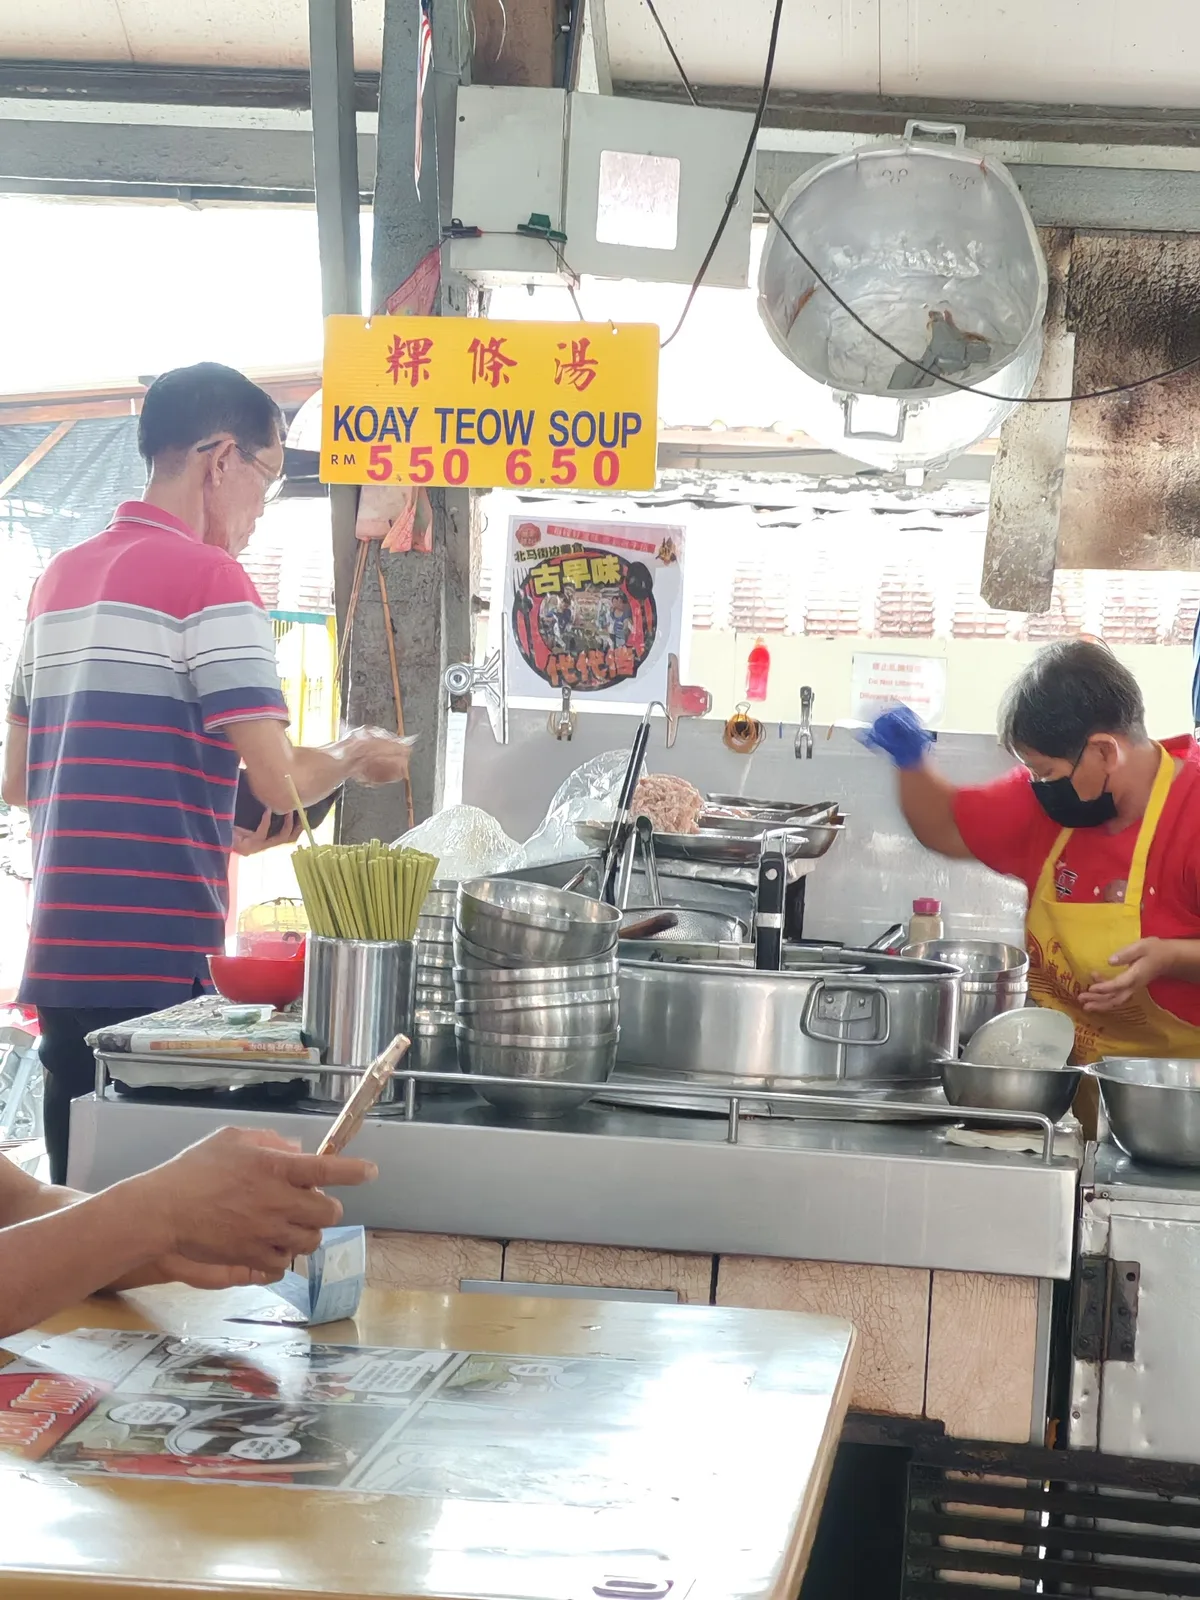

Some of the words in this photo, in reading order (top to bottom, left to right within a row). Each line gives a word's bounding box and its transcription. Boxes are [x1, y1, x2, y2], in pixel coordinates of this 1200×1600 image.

[385, 334, 599, 392] 粿條湯
[332, 405, 419, 442] KOAY
[434, 407, 535, 446] TEOW
[548, 410, 642, 449] SOUP
[331, 453, 356, 465] RM
[530, 554, 622, 595] 古早味
